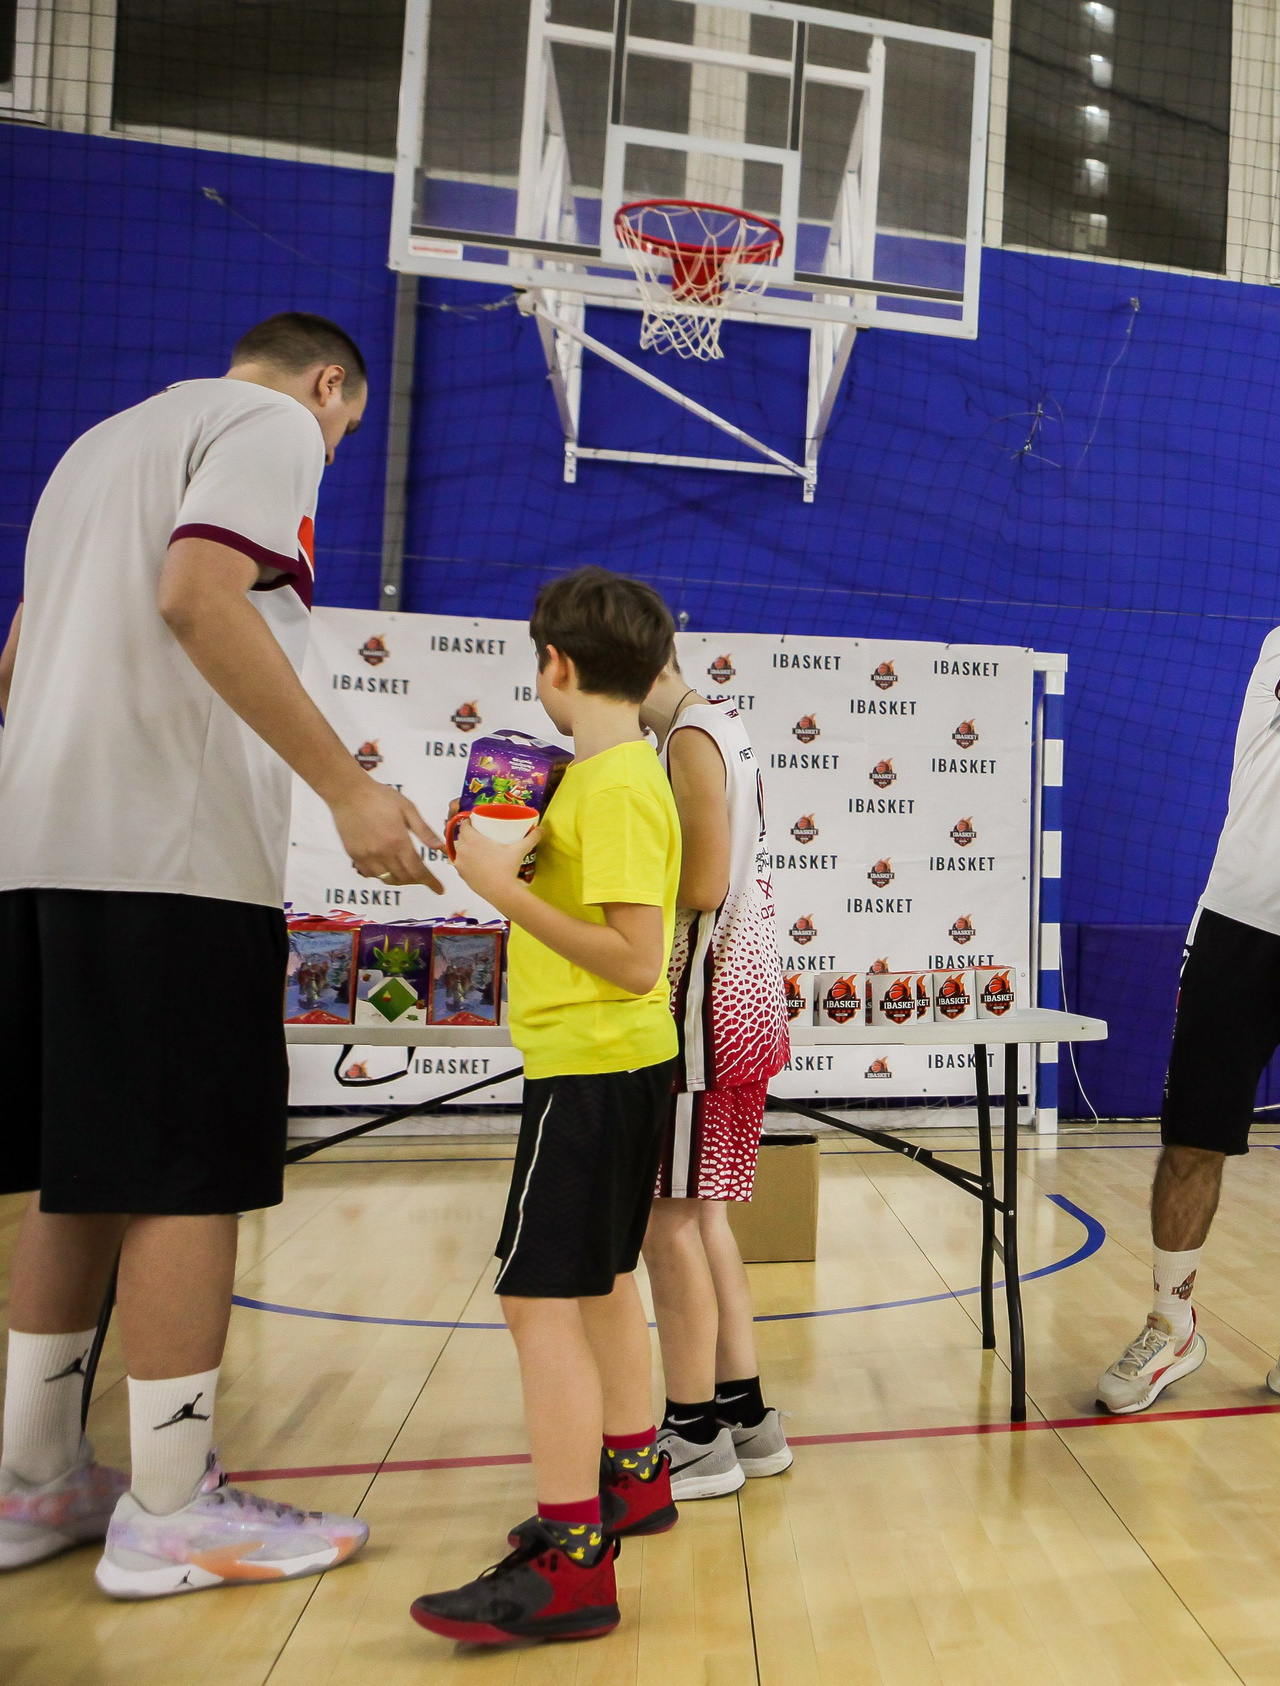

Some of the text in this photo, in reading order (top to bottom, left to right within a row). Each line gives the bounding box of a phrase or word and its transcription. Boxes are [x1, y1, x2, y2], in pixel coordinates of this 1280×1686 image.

[431, 636, 506, 656] IBASKET
[773, 653, 841, 671] IBASKET
[934, 660, 999, 677] IBASKET
[333, 674, 410, 695] IBASKET
[850, 699, 917, 716] IBASKET
[426, 741, 468, 758] IBAS
[771, 753, 839, 770] IBASKET
[931, 758, 997, 775] IBASKET
[848, 798, 915, 814] IBASKET
[769, 854, 838, 870] IBASKET
[929, 856, 995, 872] IBASKET
[326, 888, 402, 906] IBASKET
[847, 898, 913, 913] IBASKET
[928, 954, 995, 969] IBASKET
[826, 1000, 860, 1008] IBASKET
[883, 1000, 915, 1010] IBASKET
[938, 996, 969, 1005] IBASKET
[984, 993, 1014, 1003] IBASKET
[414, 1058, 490, 1075] IBASKET
[784, 1055, 834, 1071] ASKET
[928, 1053, 995, 1069] IBASKT
